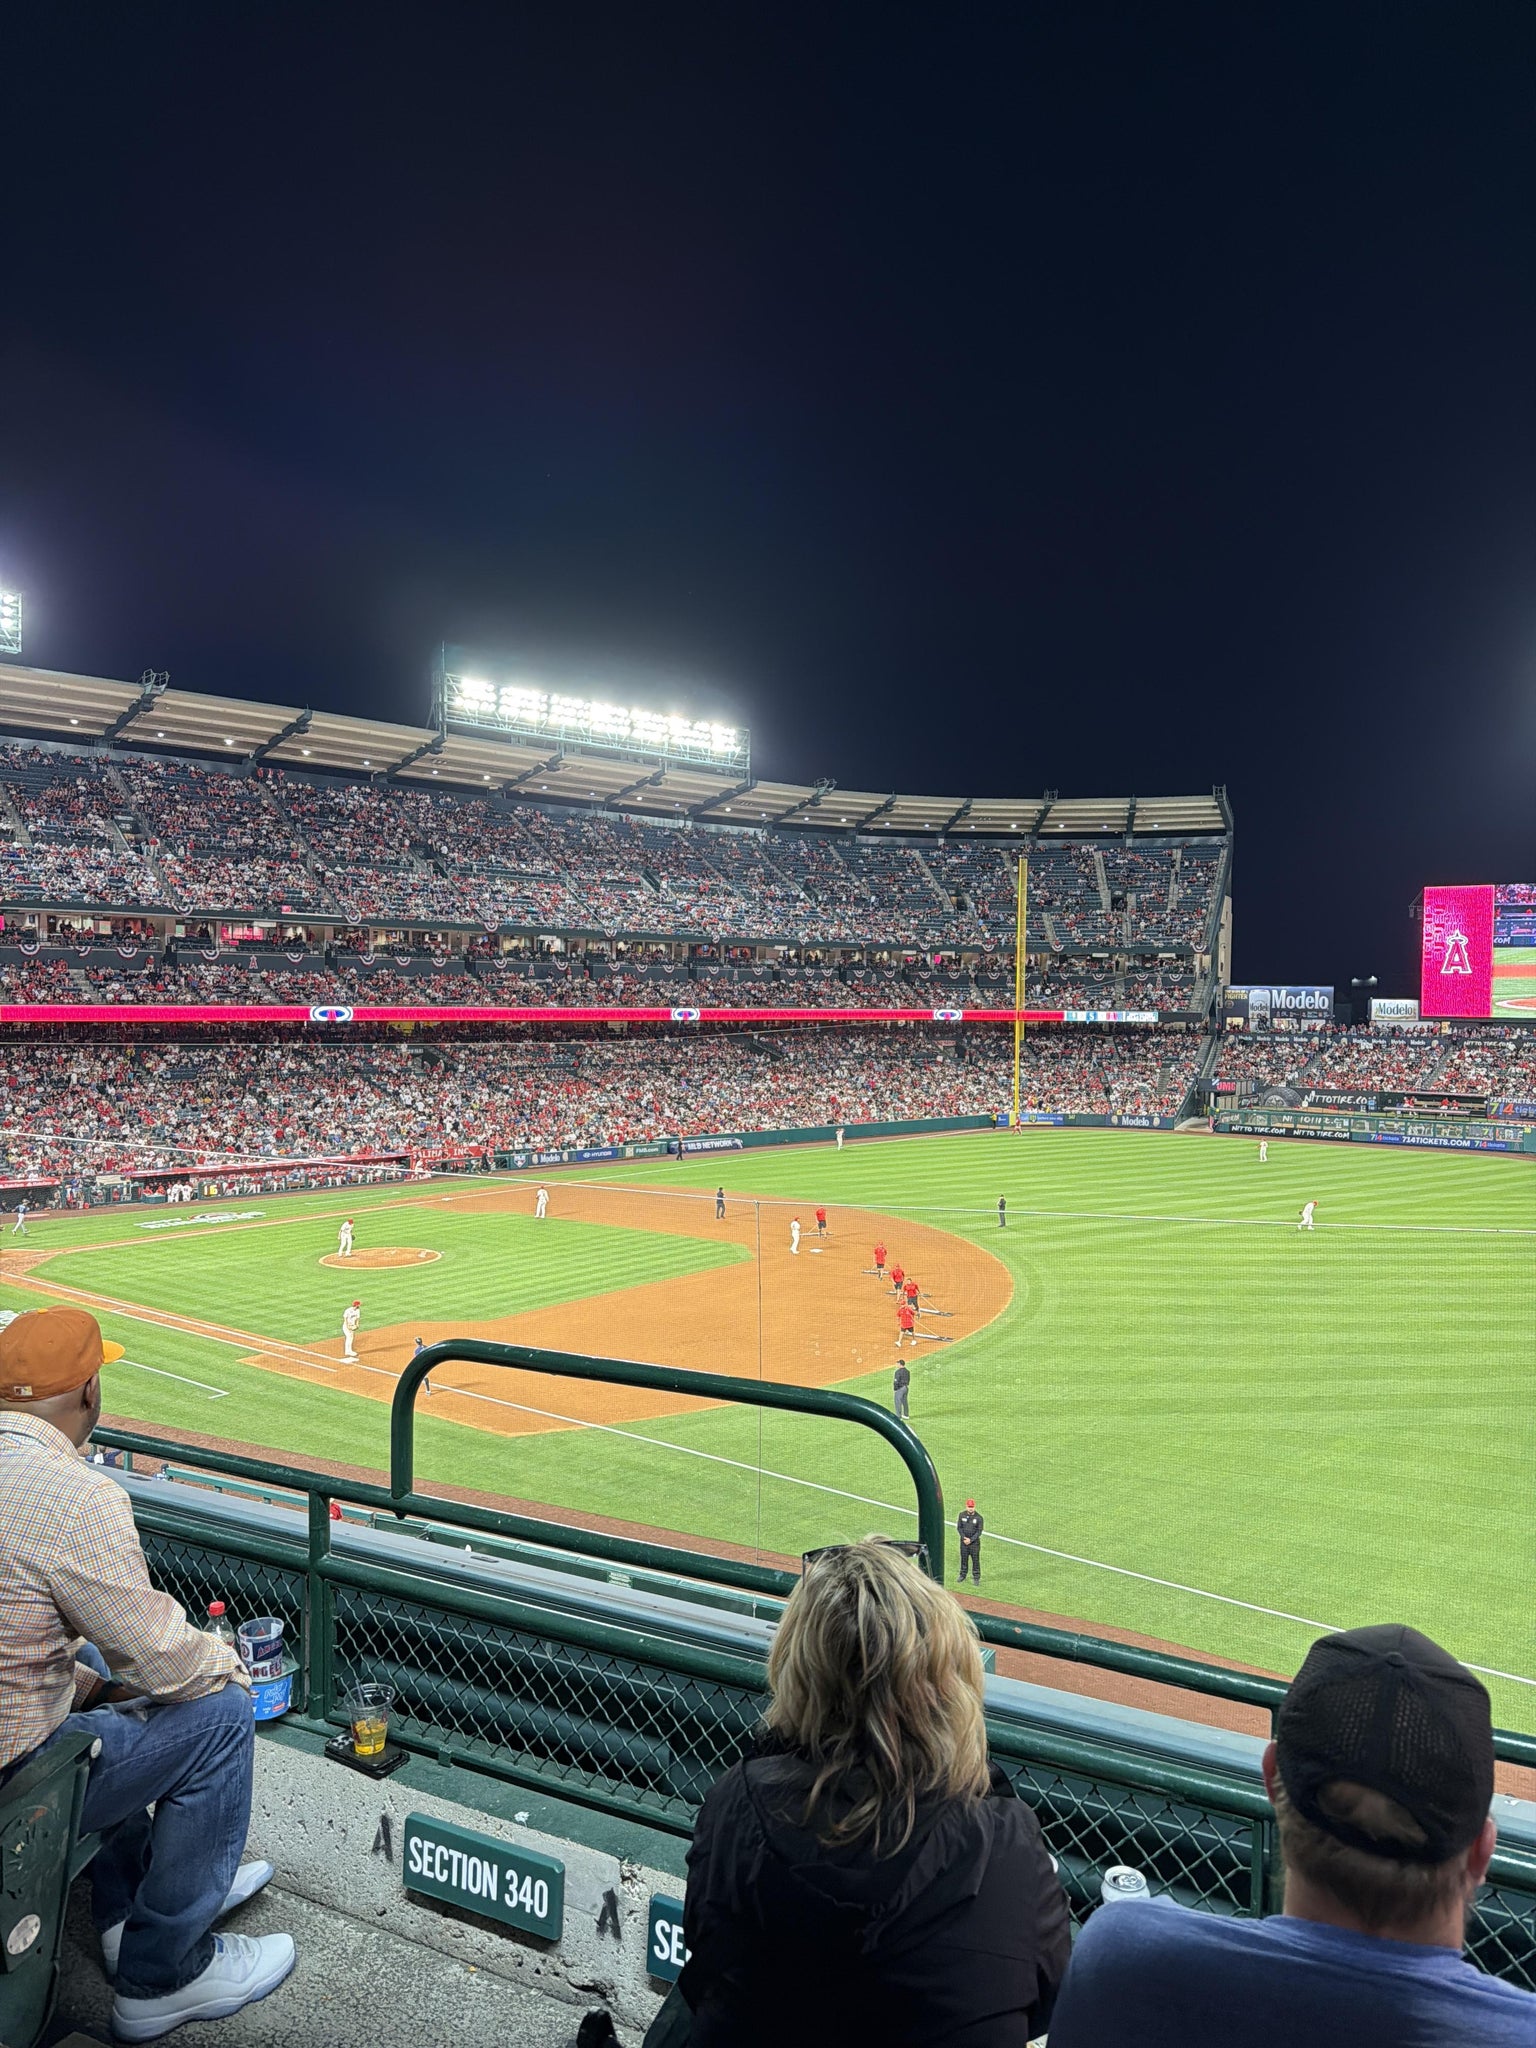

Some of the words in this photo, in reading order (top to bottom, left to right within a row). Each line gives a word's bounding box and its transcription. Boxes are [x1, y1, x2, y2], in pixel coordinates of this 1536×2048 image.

[1271, 988, 1329, 1010] Modelo
[1378, 1002, 1413, 1016] Modelo
[1121, 1116, 1150, 1127] Modelo
[1231, 1124, 1252, 1133] NITTO
[1254, 1126, 1286, 1135] TIRE.COM
[1293, 1128, 1314, 1137] NITTO
[1316, 1129, 1350, 1139] TIRE.COM
[687, 1143, 702, 1151] MLB
[703, 1139, 733, 1149] NETWORK
[1402, 1136, 1471, 1147] 714TICKETS.COM
[408, 1836, 499, 1901] SECTION
[504, 1869, 549, 1919] 340
[653, 1919, 693, 1968] SE
